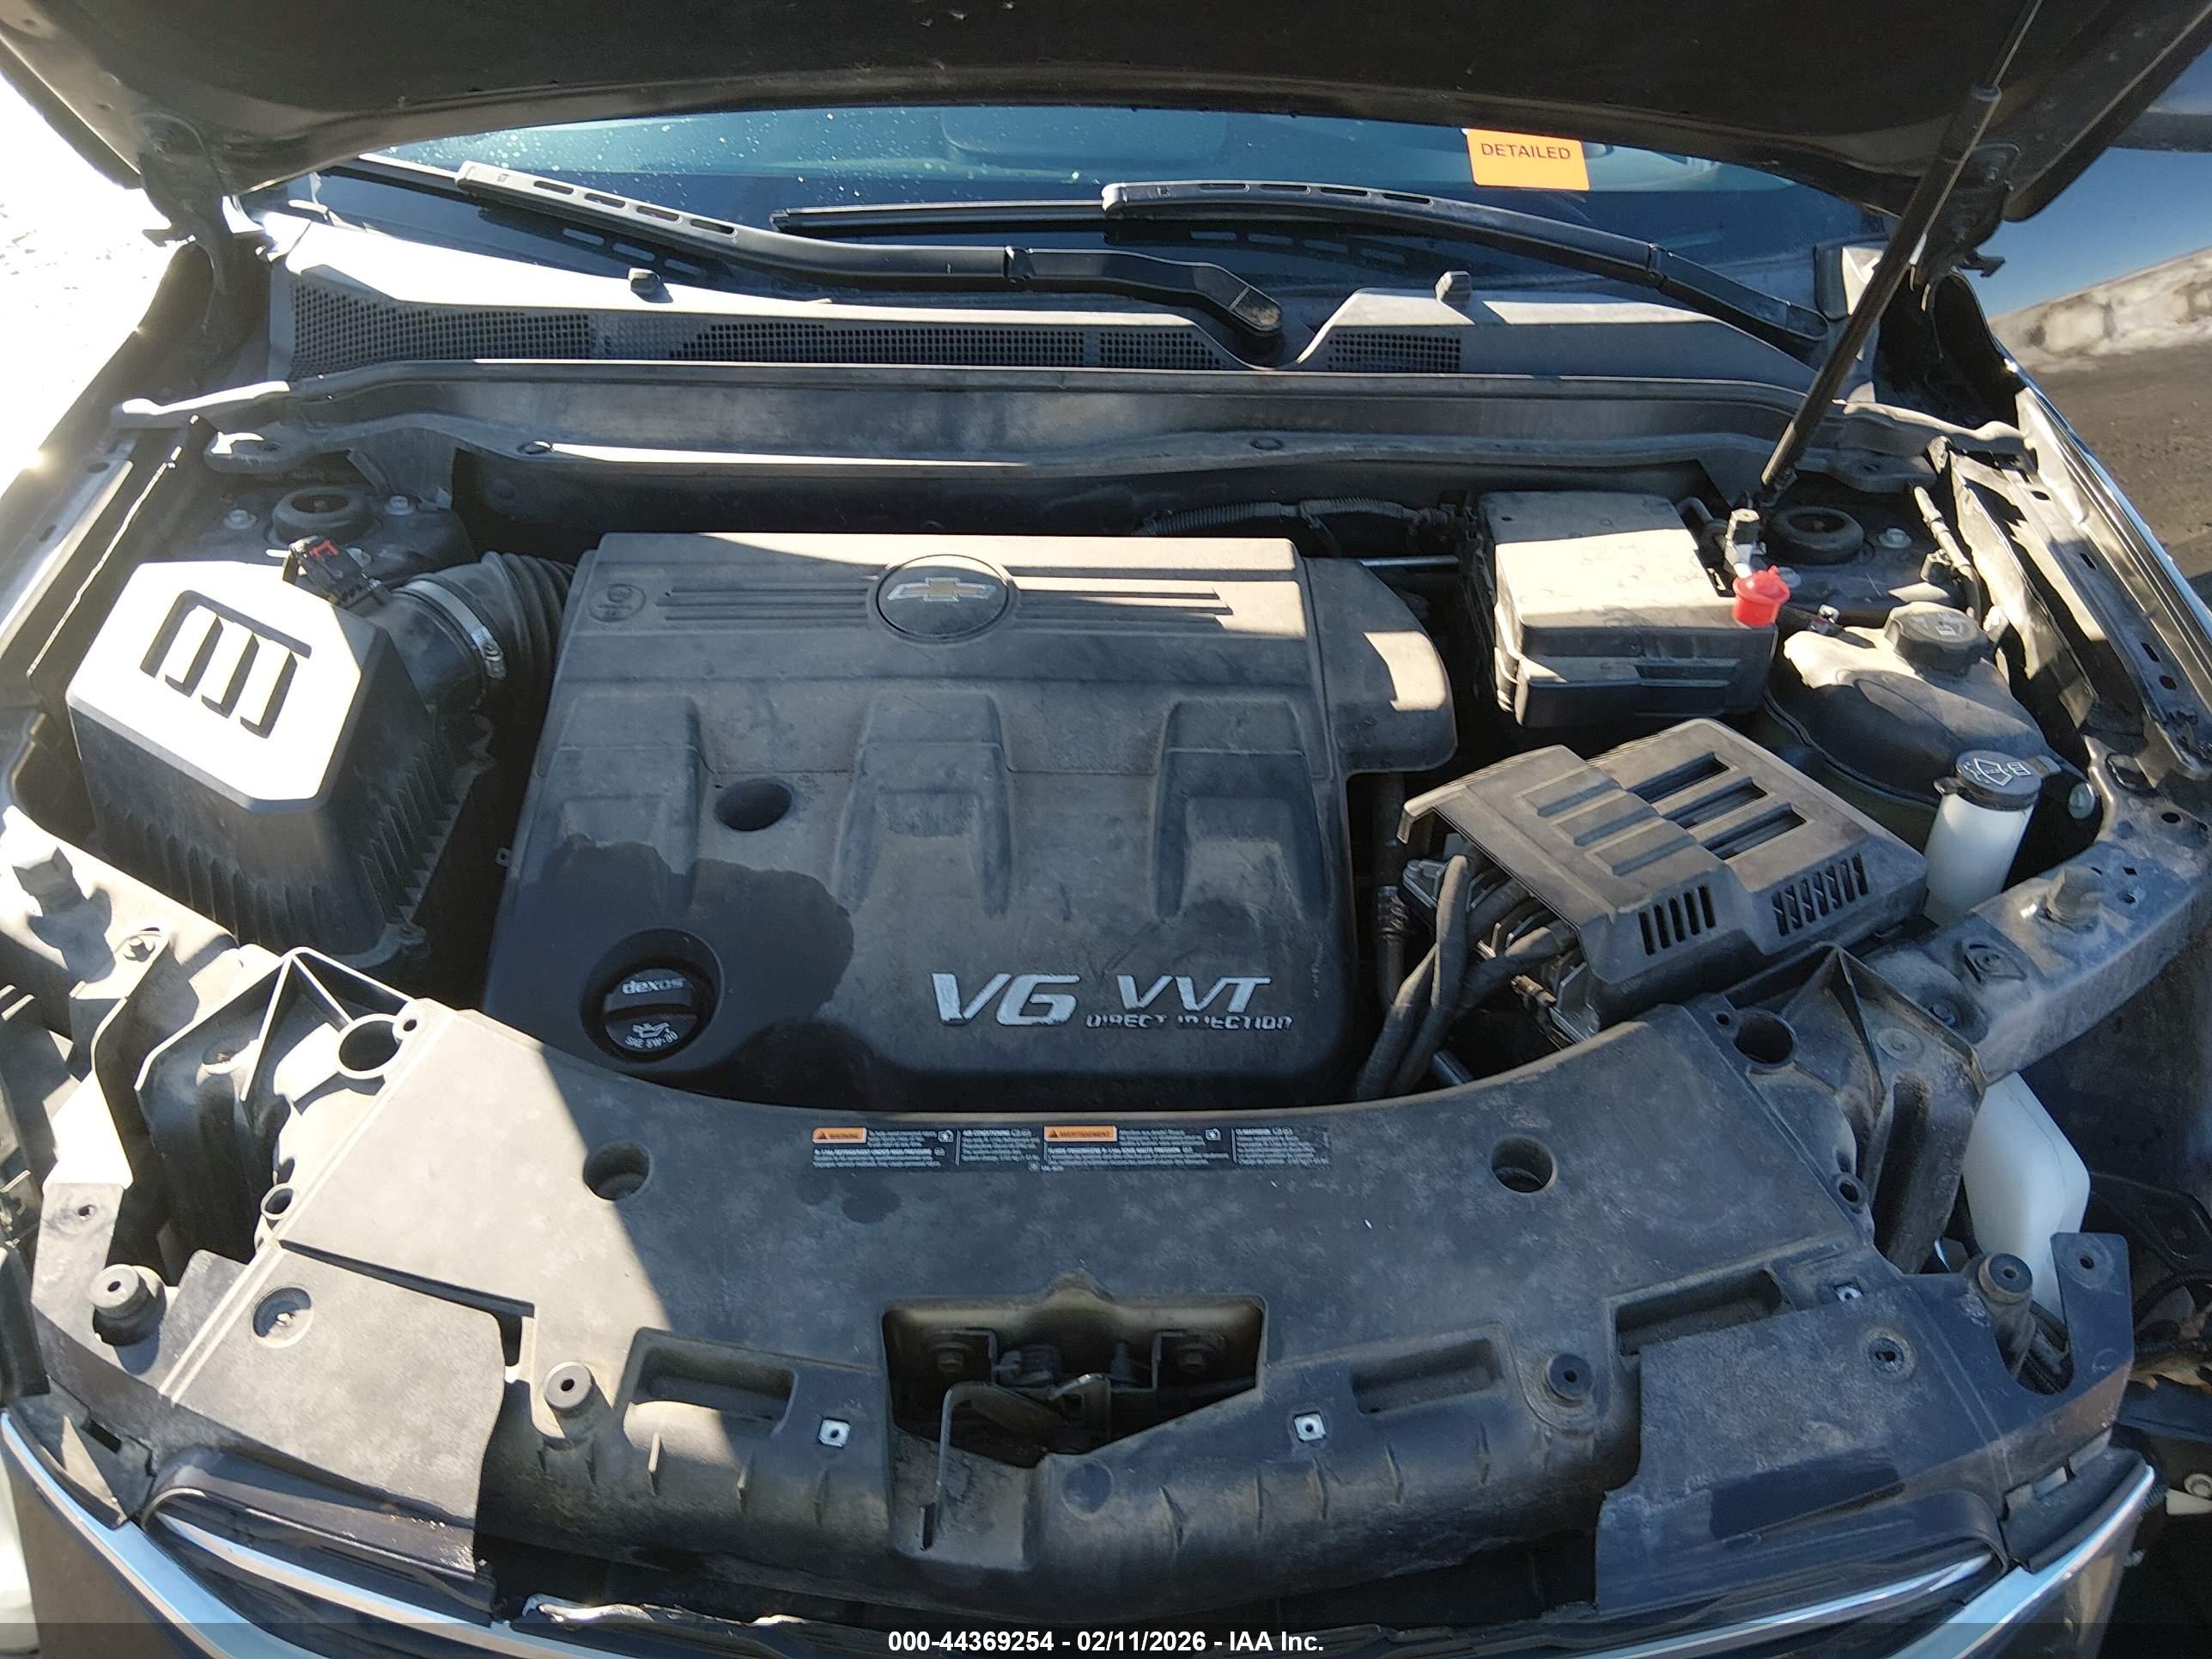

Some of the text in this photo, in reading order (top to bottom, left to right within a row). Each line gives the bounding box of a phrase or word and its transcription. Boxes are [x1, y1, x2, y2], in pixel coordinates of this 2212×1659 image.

[1480, 143, 1571, 160] DETAILED
[623, 978, 684, 994] dexos
[931, 972, 1272, 1026] V6 VVT
